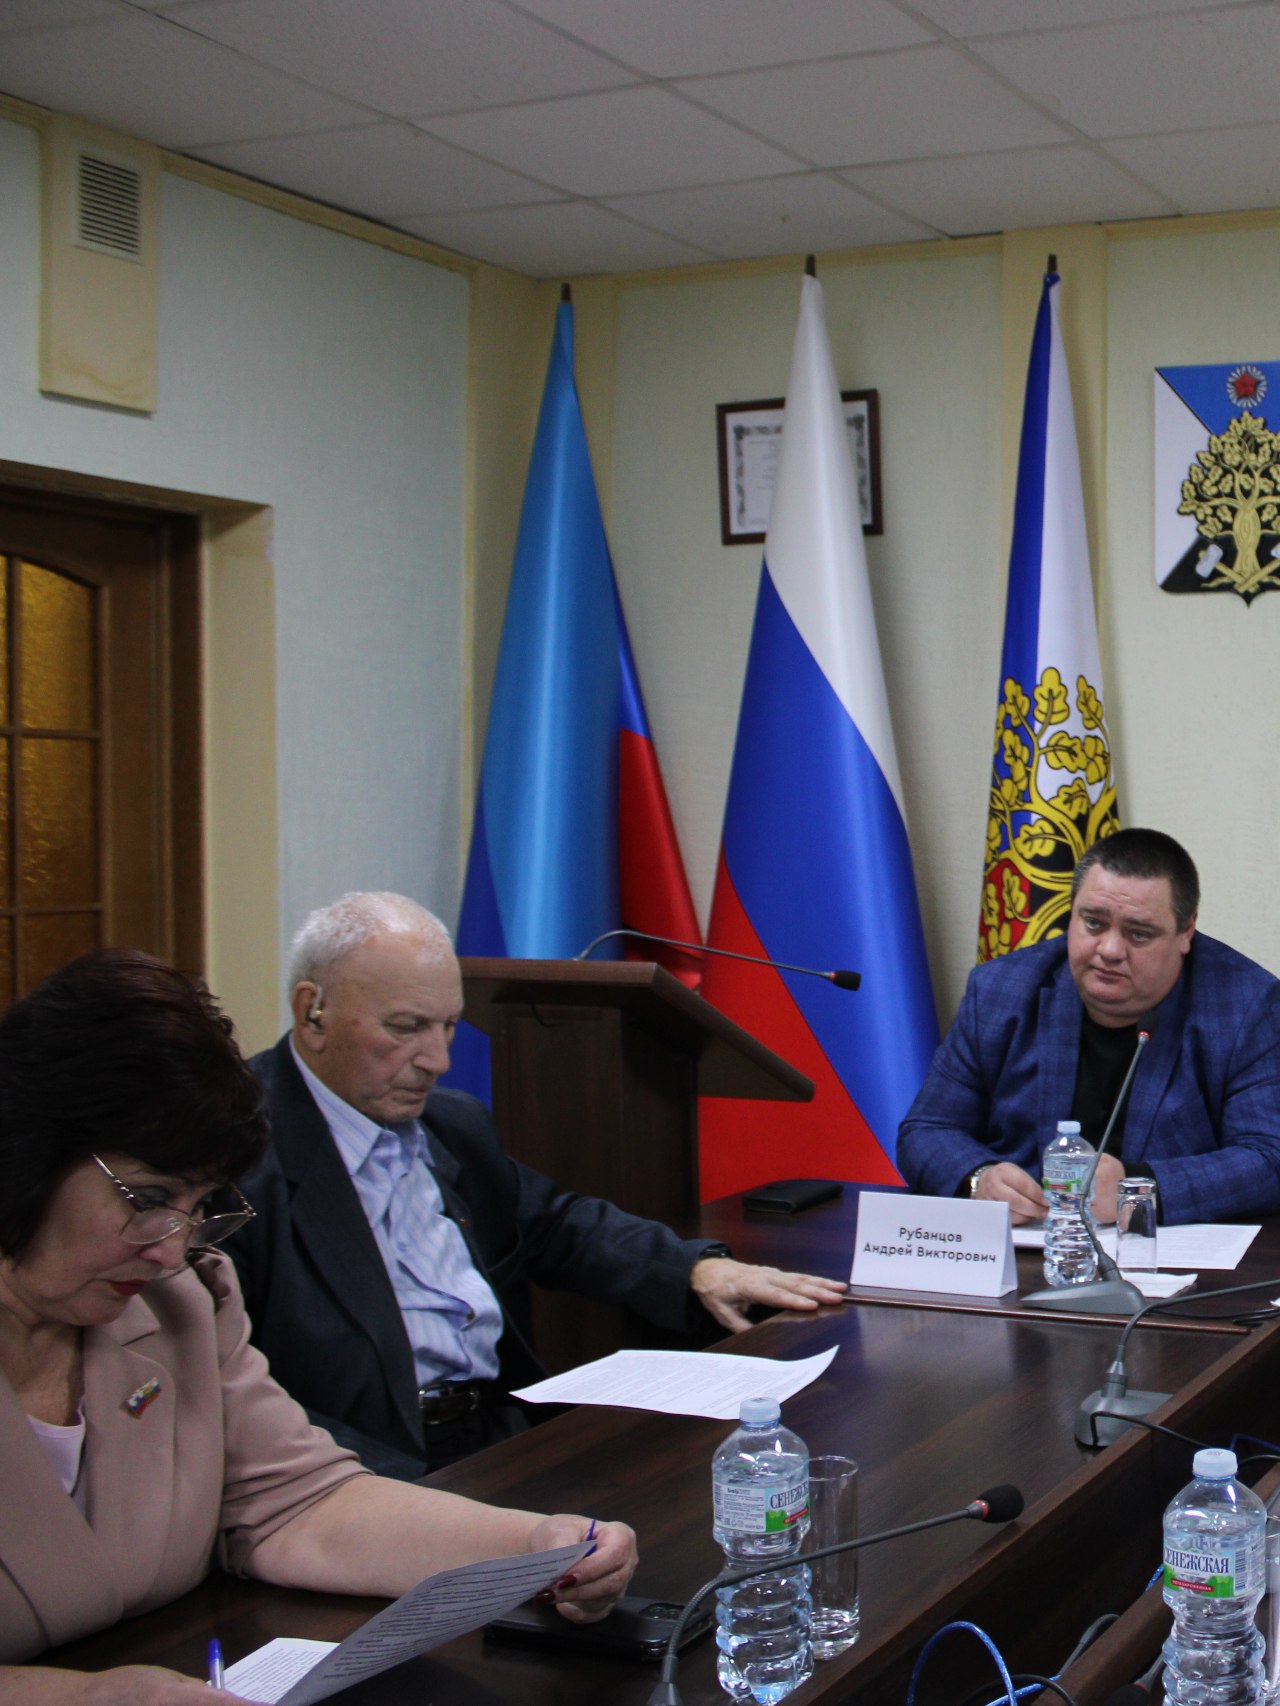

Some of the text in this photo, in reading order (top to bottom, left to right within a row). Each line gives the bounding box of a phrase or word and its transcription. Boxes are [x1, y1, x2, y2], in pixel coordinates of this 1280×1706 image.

[899, 1227, 962, 1242] Рубанцов
[863, 1242, 996, 1263] Андрей Викторович
